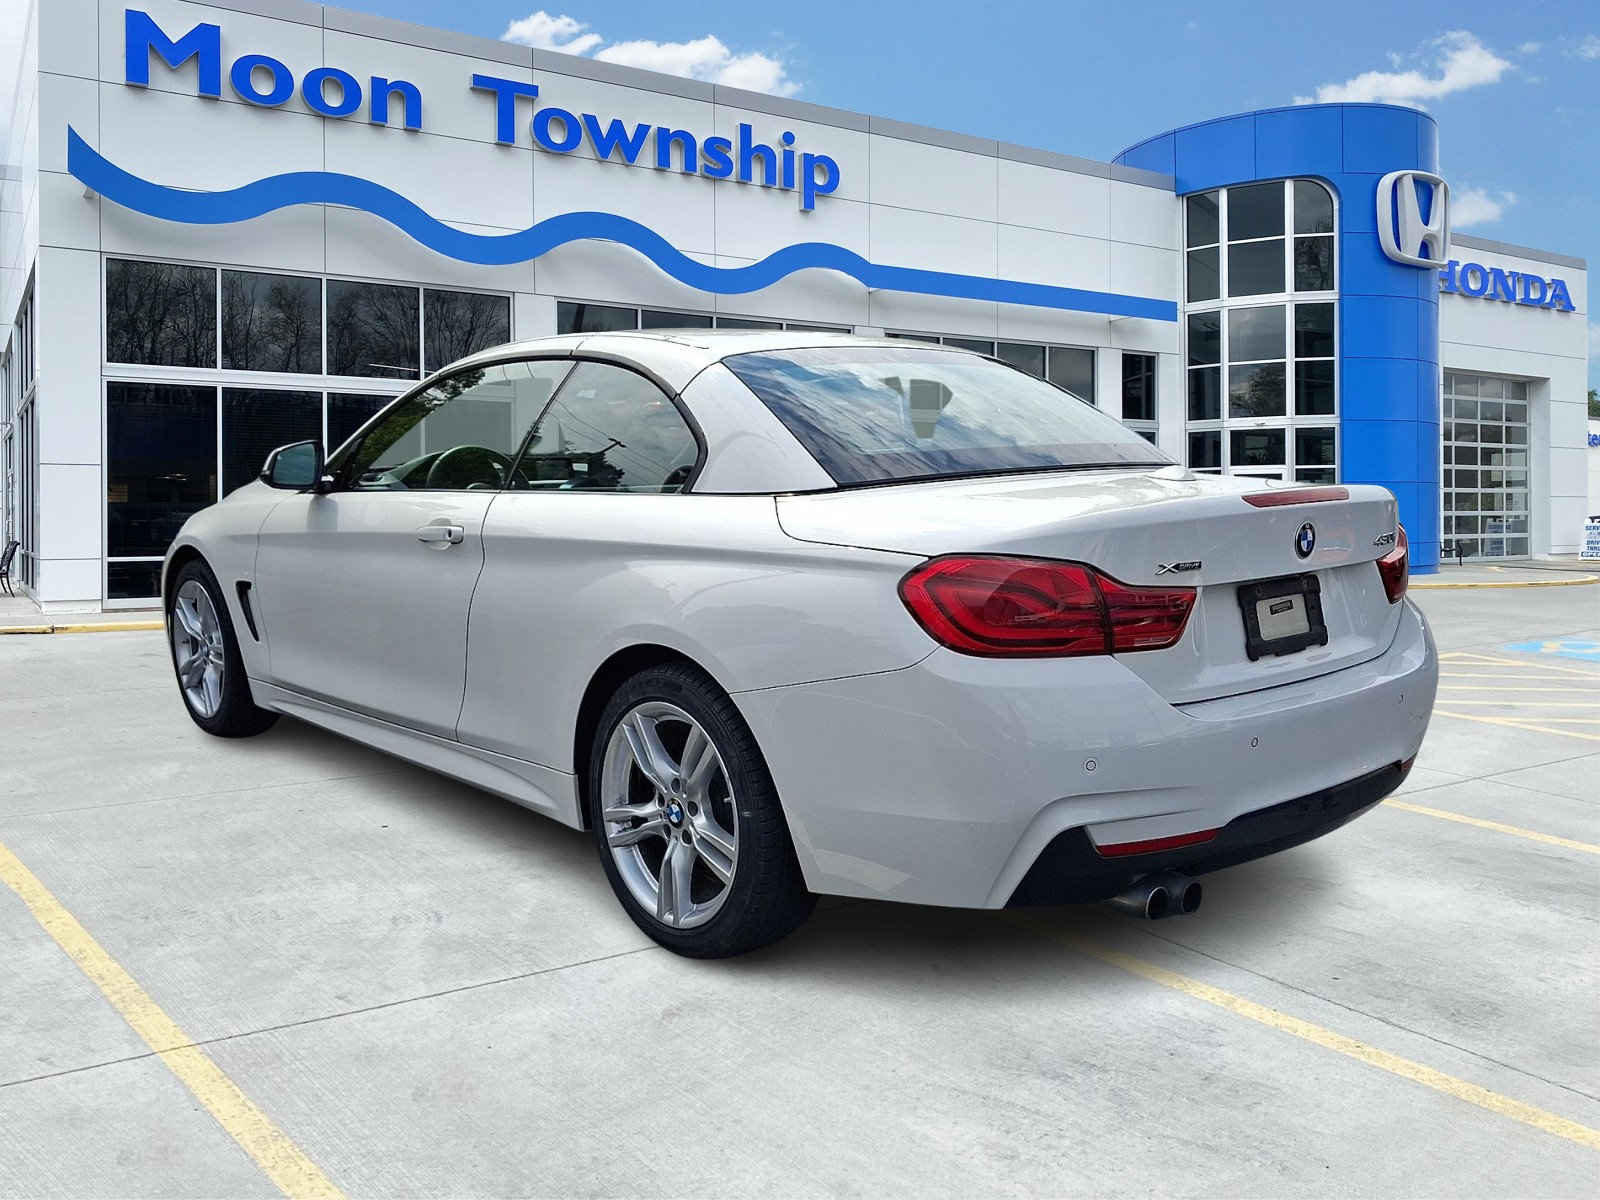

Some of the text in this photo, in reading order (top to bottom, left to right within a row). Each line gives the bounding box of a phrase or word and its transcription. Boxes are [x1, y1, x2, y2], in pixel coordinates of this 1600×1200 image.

[125, 9, 840, 212] Moon Township
[1439, 260, 1576, 312] HONDA
